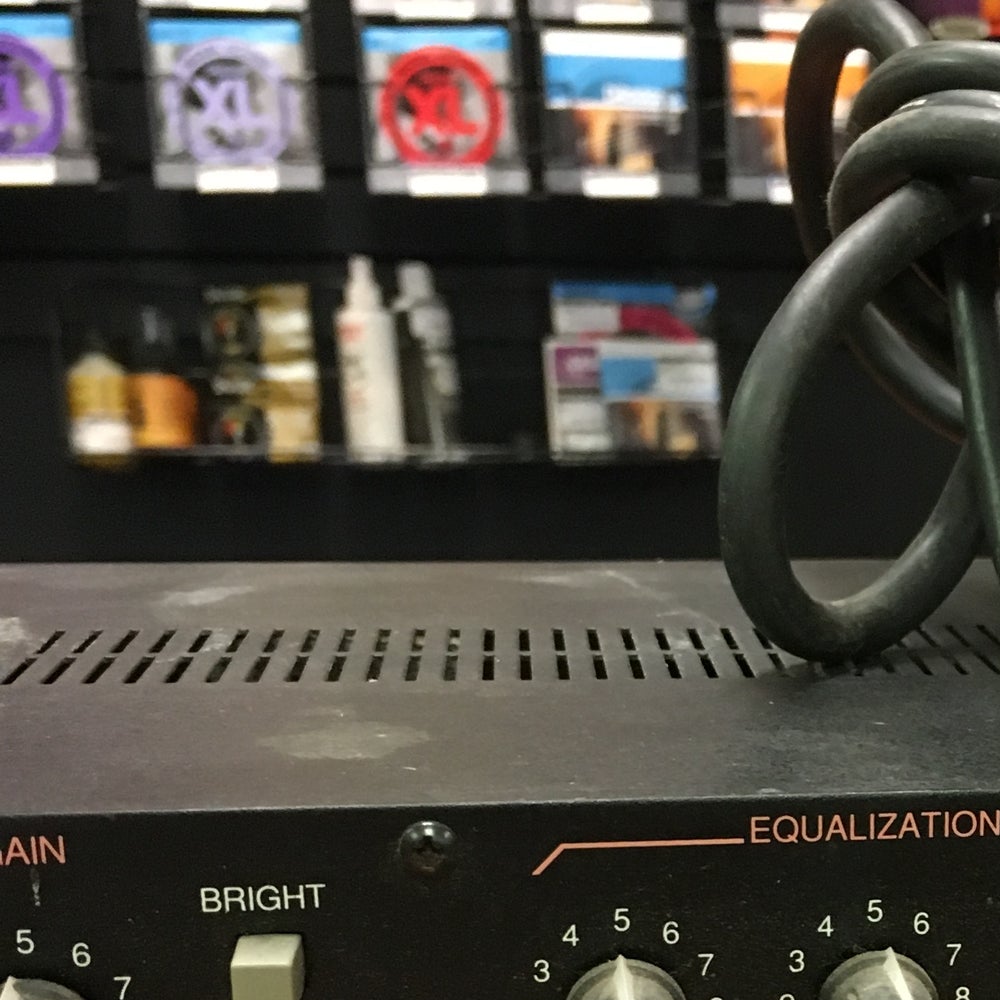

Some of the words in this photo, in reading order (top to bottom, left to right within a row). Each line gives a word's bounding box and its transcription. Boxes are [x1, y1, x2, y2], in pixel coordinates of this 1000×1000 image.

[750, 809, 1000, 844] EQUALIZATION
[0, 835, 66, 866] AIN
[200, 883, 326, 913] BRIGHT
[613, 907, 631, 932] 5
[866, 899, 883, 923] 5
[913, 911, 930, 935] 6
[562, 924, 580, 947] 4
[662, 920, 680, 945] 6
[817, 915, 834, 937] 4
[16, 929, 35, 955] 5
[71, 942, 91, 968] 6
[697, 953, 714, 977] 7
[788, 949, 805, 973] 3
[946, 943, 962, 966] 7
[533, 959, 551, 983] 3
[113, 975, 132, 1000] 7
